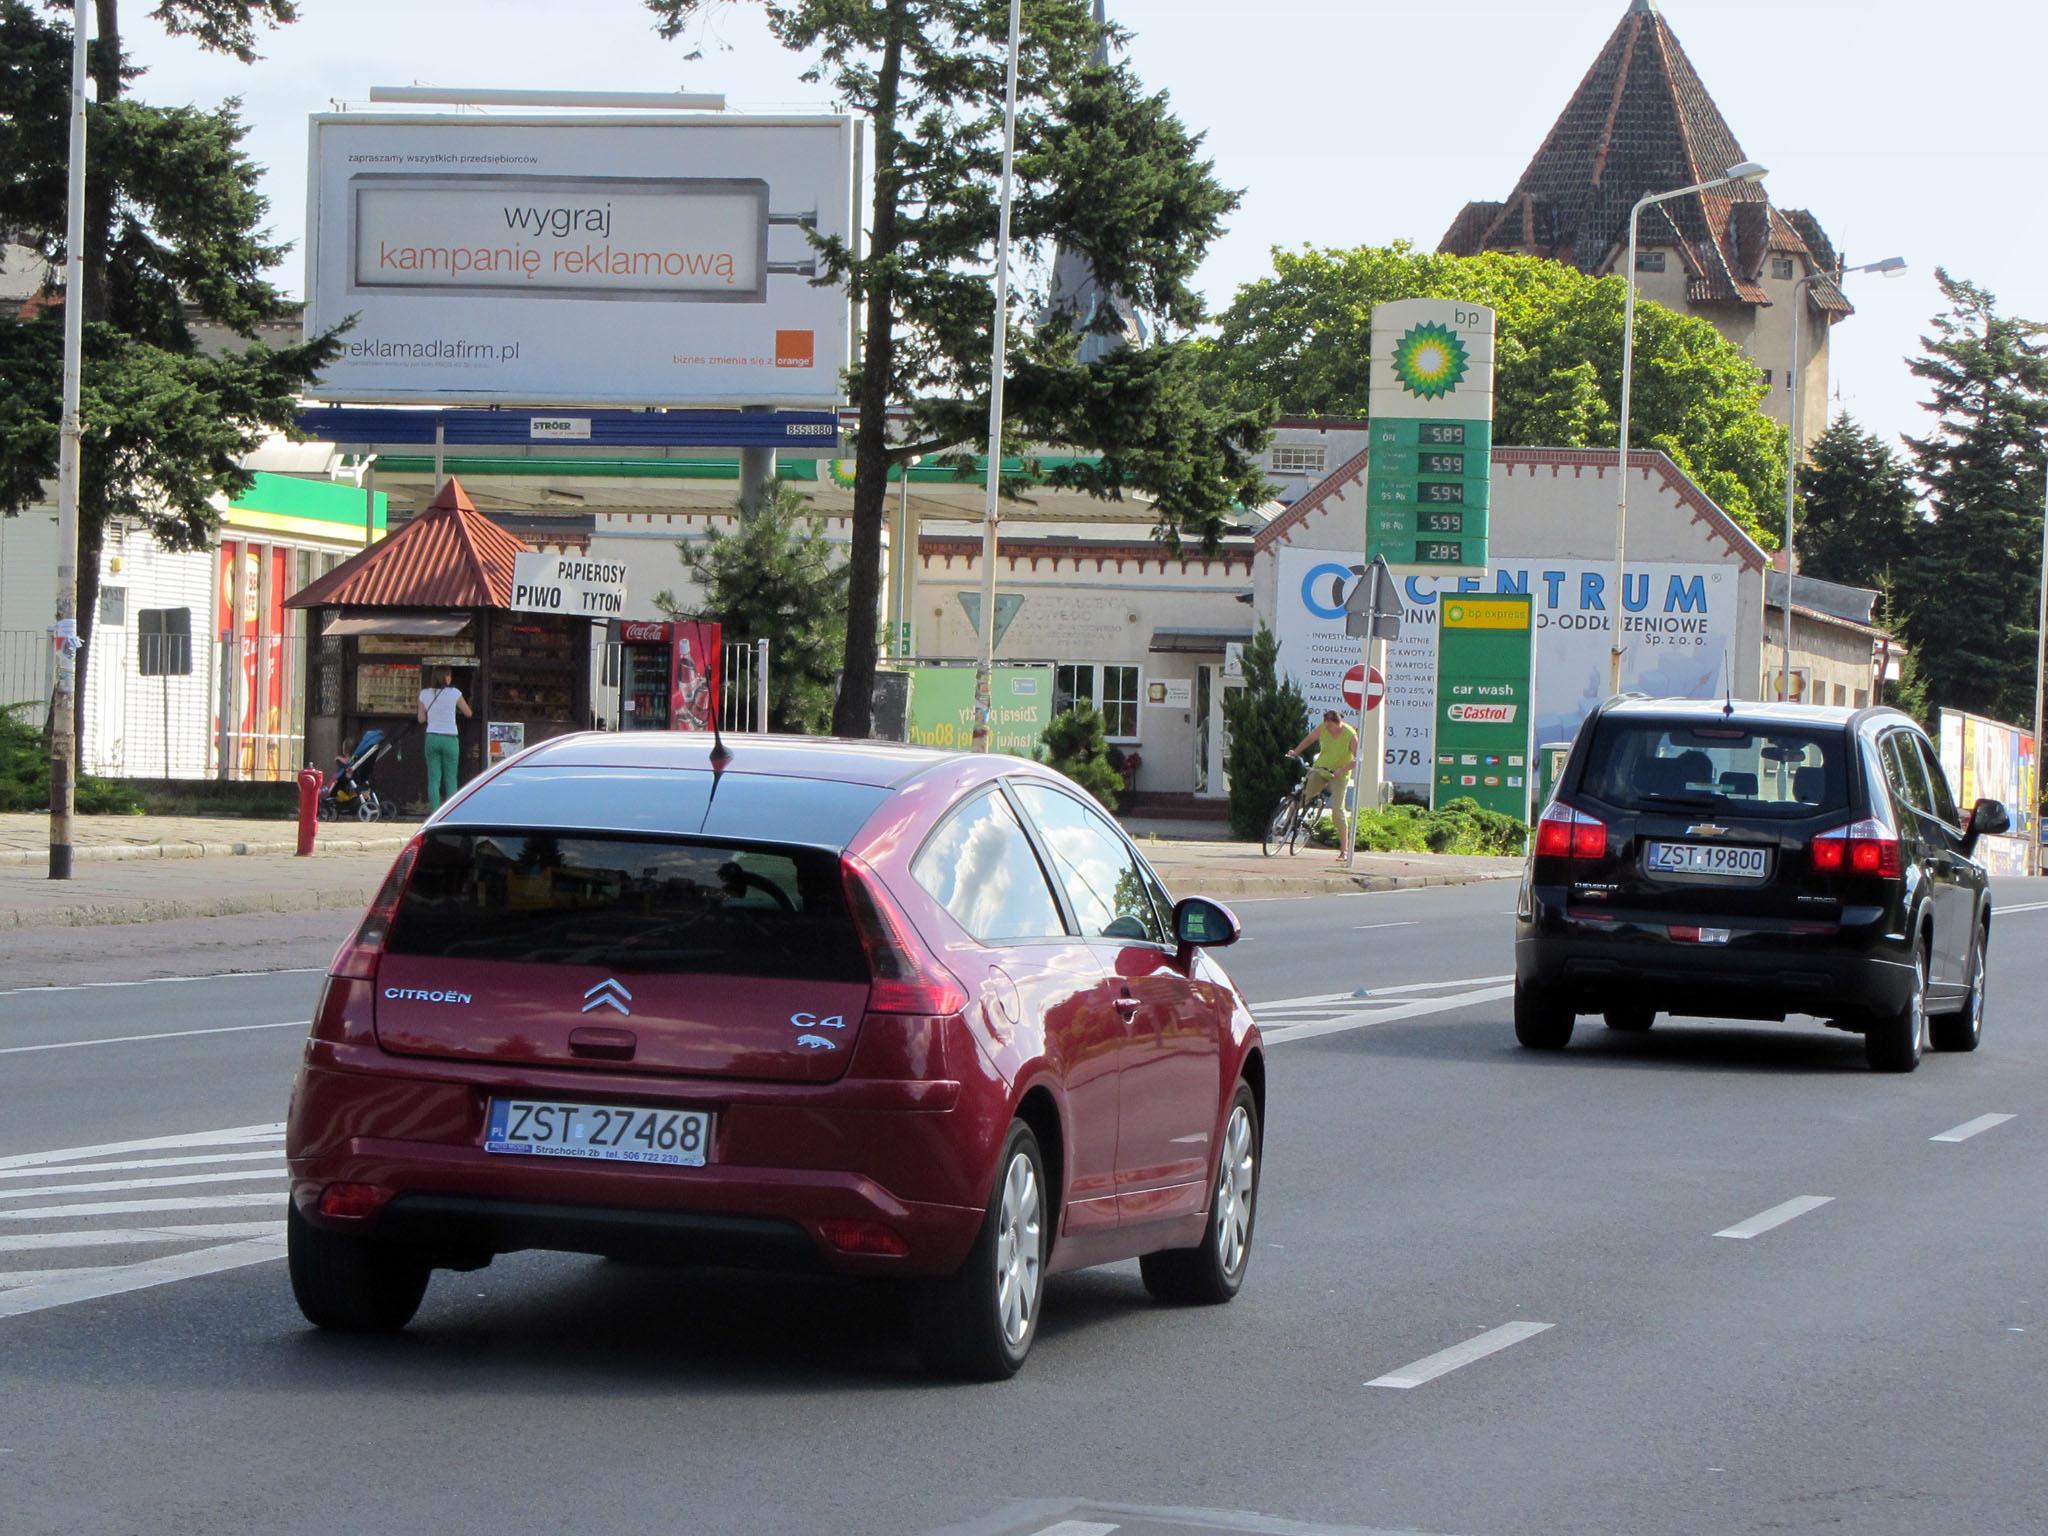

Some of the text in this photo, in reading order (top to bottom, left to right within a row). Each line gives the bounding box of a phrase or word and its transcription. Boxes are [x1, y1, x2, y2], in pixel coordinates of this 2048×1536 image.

[348, 154, 403, 165] zapraszamy
[406, 153, 458, 165] wszystkich
[504, 203, 611, 238] wygraj
[380, 241, 735, 284] kampanię reklamową
[1454, 308, 1480, 328] bp
[343, 338, 520, 363] reklamadlafirm.pl
[672, 355, 706, 365] biznes
[777, 357, 810, 367] orange
[558, 562, 626, 583] PAPIEROSY
[516, 585, 561, 608] PIWO
[583, 589, 621, 612] TYTOŃ
[1468, 609, 1526, 620] bp express
[1645, 634, 1664, 647] Sp.
[1452, 684, 1514, 695] car wash
[1464, 705, 1508, 720] Castrol
[1660, 845, 1762, 870] ZST 19800
[384, 987, 472, 1004] CITROËN
[790, 1012, 846, 1028] C4
[491, 1127, 504, 1137] PL
[508, 1105, 702, 1152] ZST 27468
[535, 1145, 586, 1156] Strachocin
[588, 1148, 600, 1157] 2b
[623, 1151, 640, 1160] 506
[642, 1153, 659, 1161] 722
[661, 1154, 679, 1162] 230
